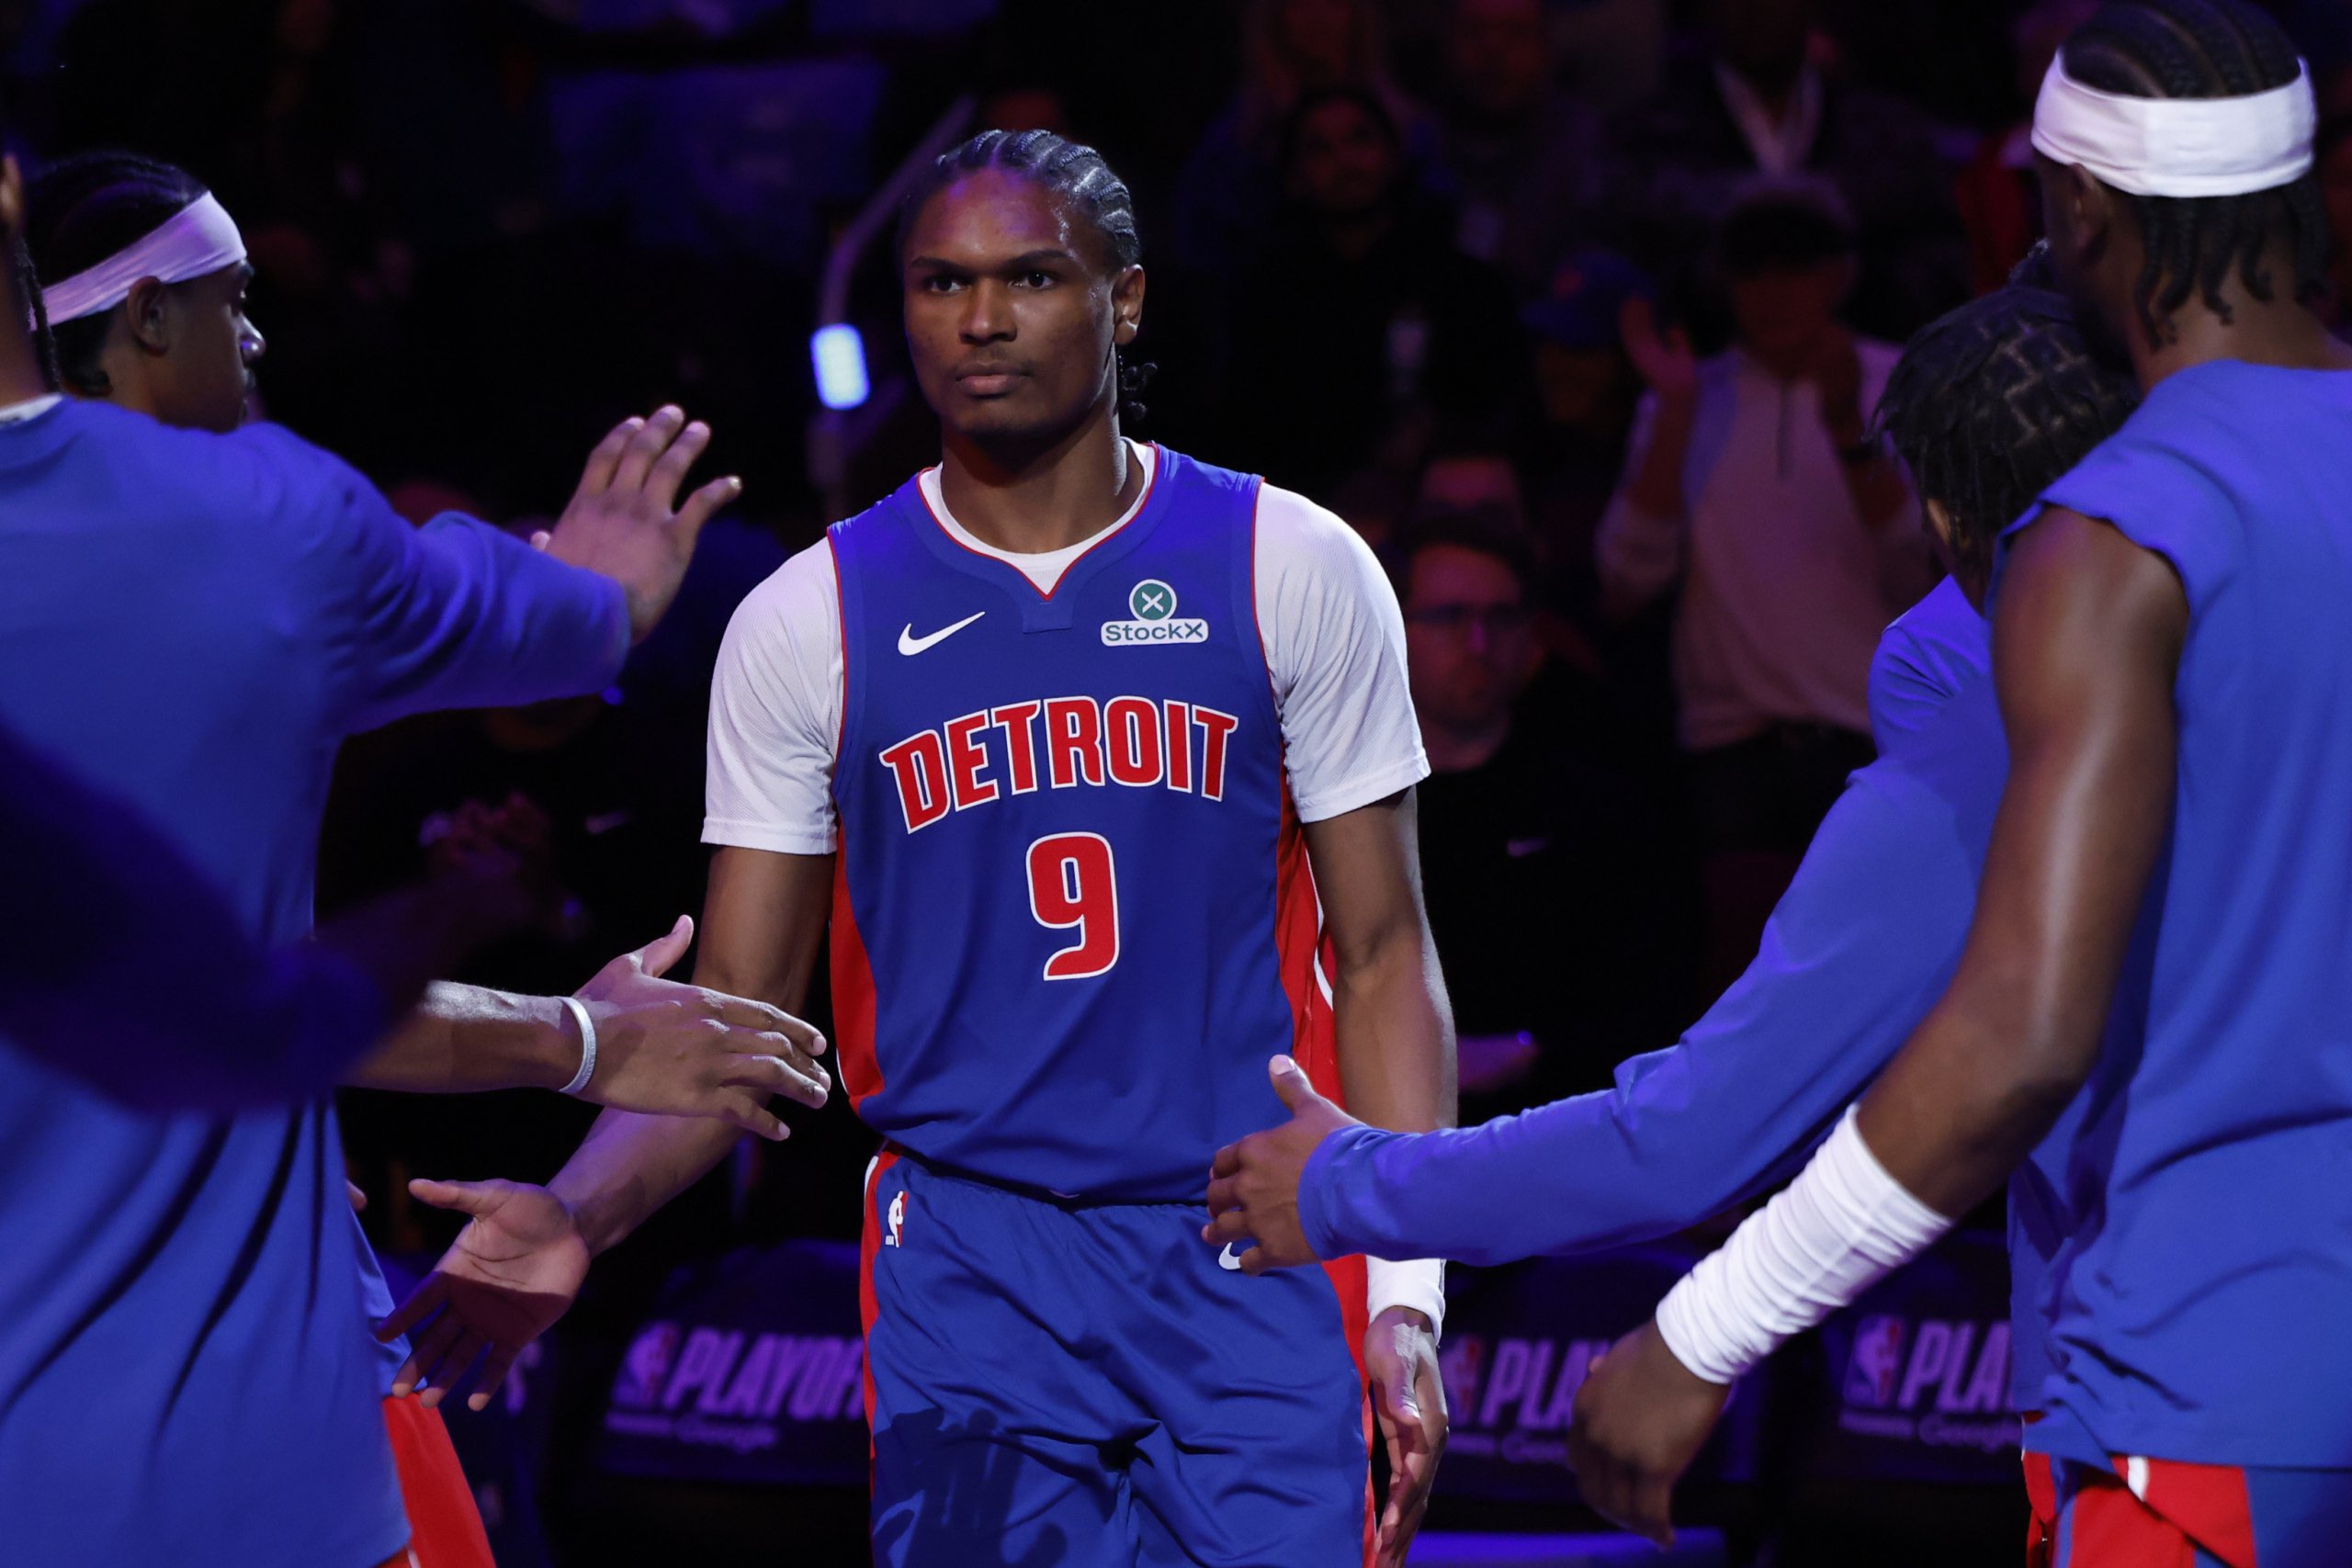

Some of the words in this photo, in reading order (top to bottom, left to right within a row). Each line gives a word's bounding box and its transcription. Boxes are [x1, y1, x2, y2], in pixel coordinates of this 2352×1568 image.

[1105, 622, 1204, 642] StockX
[878, 695, 1238, 834] DETROIT
[1025, 831, 1120, 981] 9
[1478, 1338, 1609, 1429] PLA
[1897, 1320, 2012, 1412] PLA
